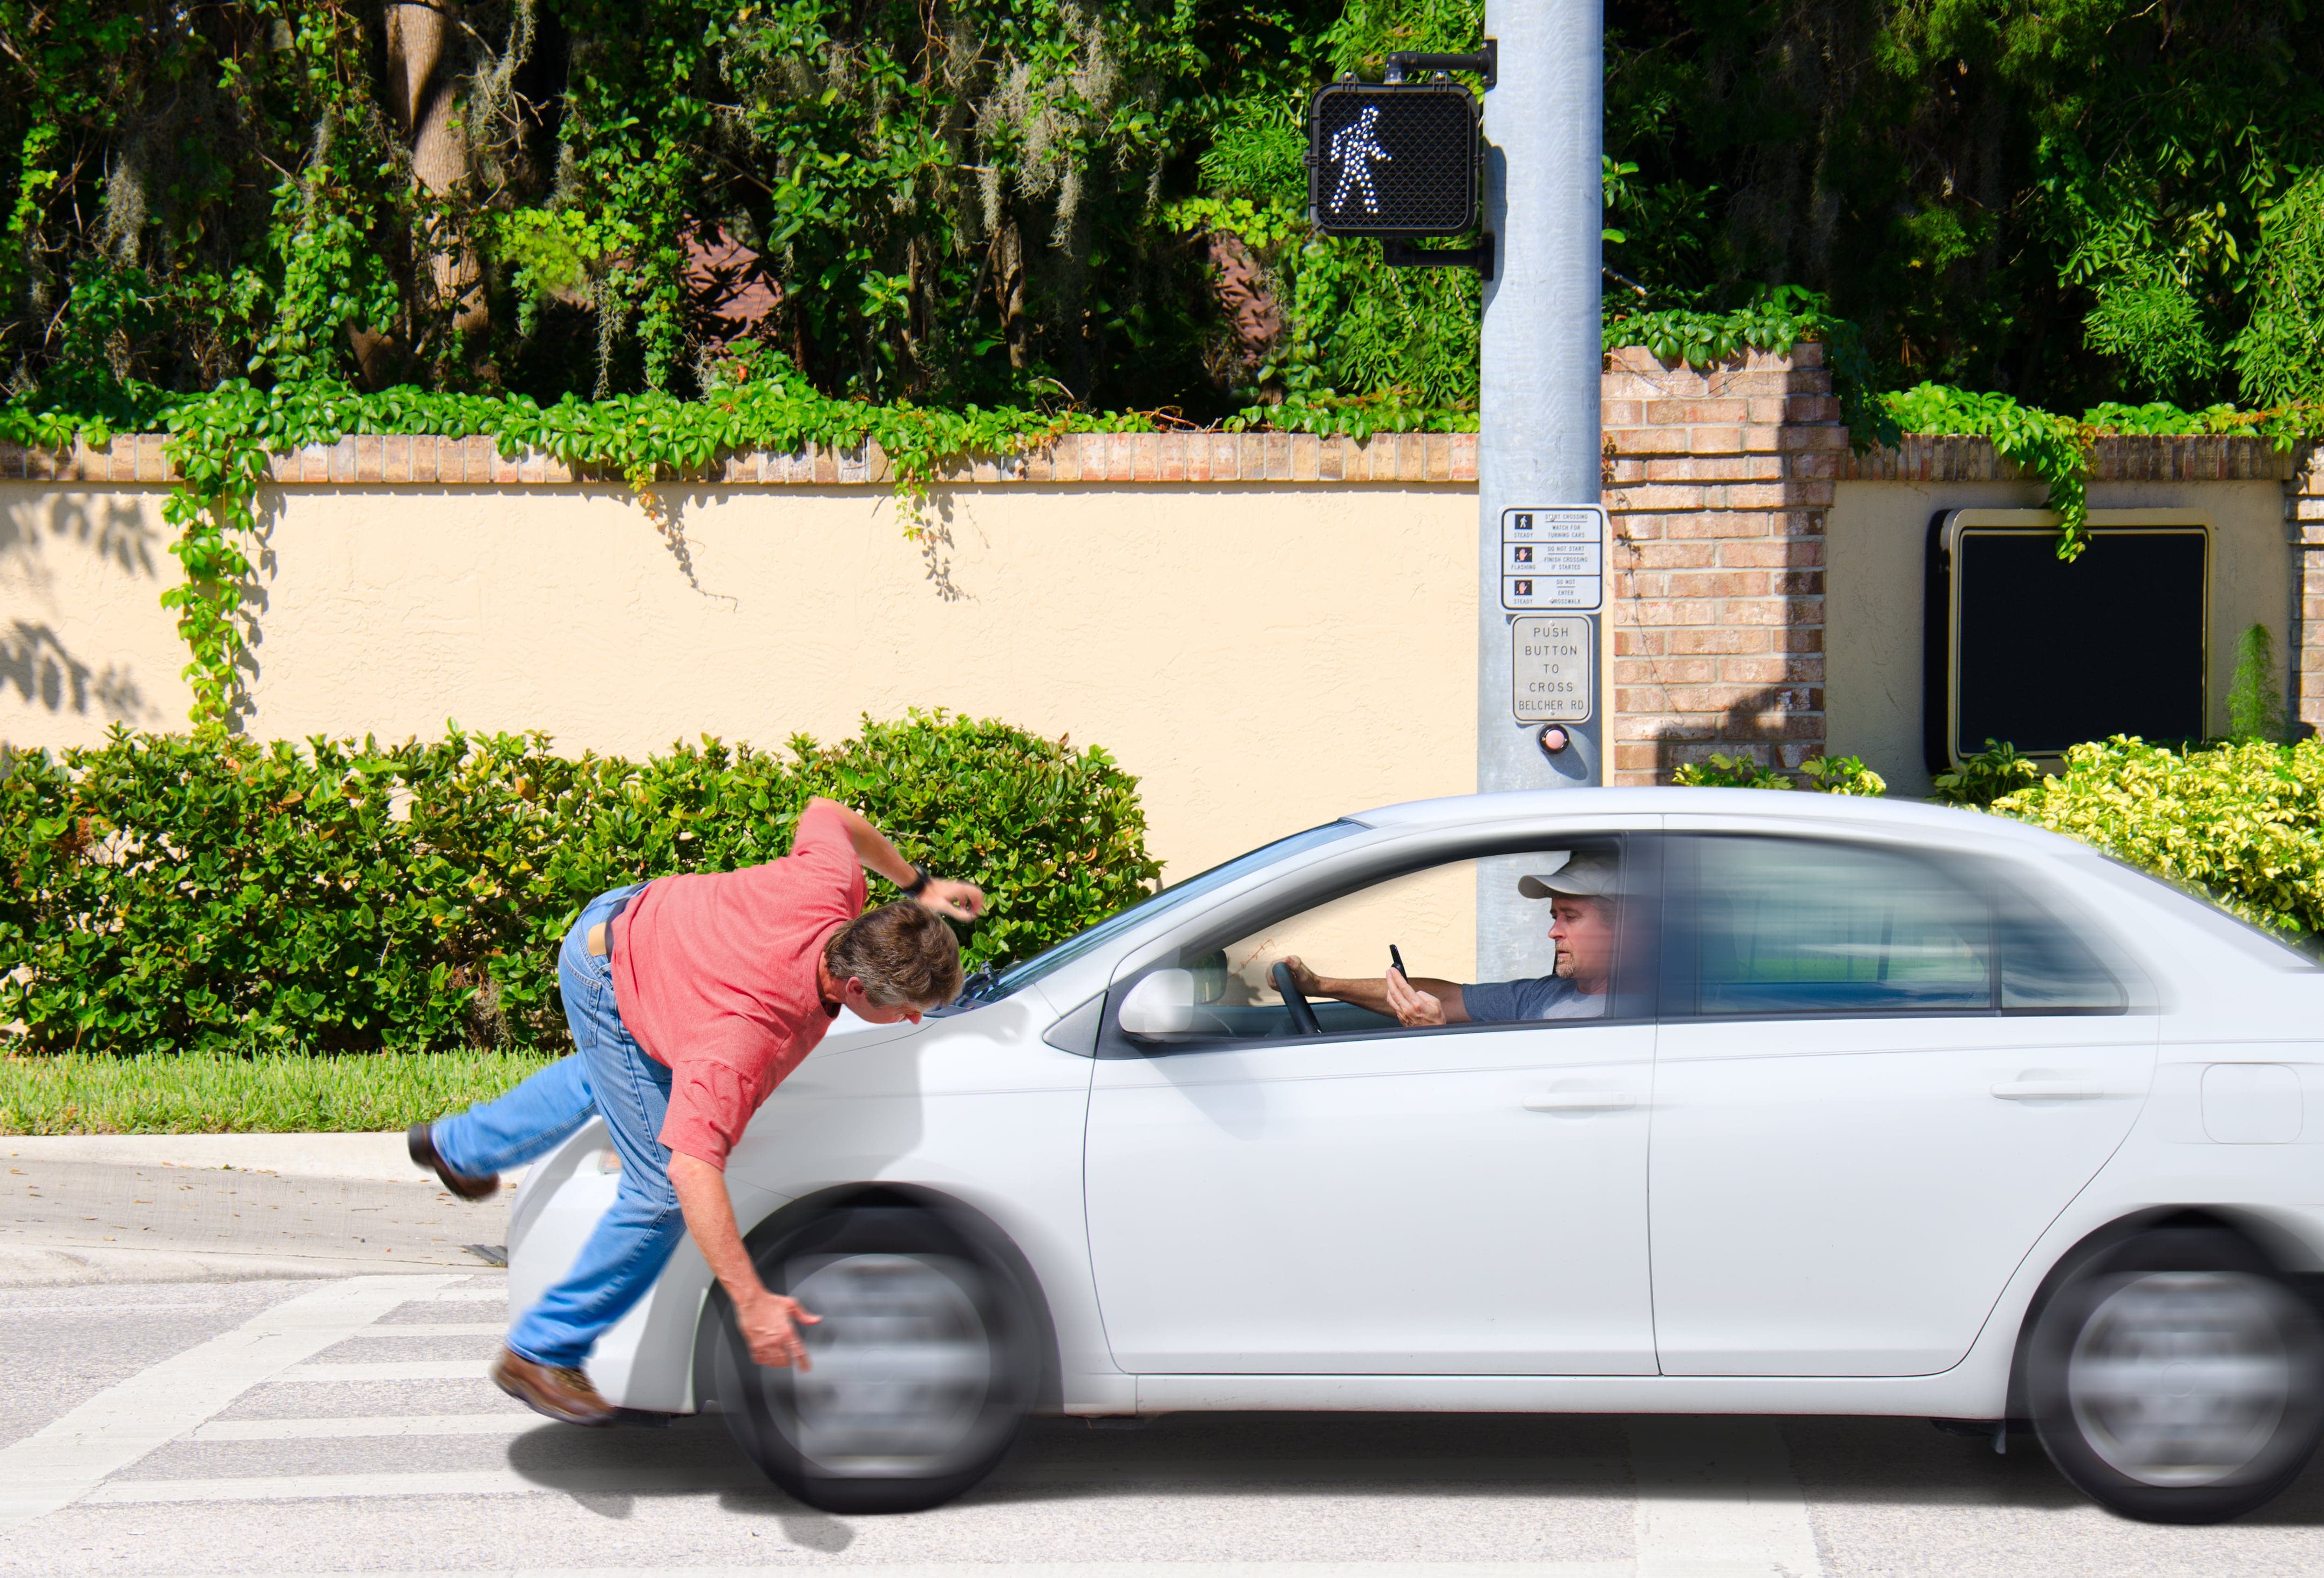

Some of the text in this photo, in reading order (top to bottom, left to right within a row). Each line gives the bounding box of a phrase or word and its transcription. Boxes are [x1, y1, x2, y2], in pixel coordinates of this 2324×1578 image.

[1533, 627, 1568, 637] PUSH
[1525, 646, 1578, 655] BUTTON
[1543, 664, 1559, 674] TO
[1529, 682, 1573, 692] CROSS
[1519, 700, 1584, 710] BELCHER RD
